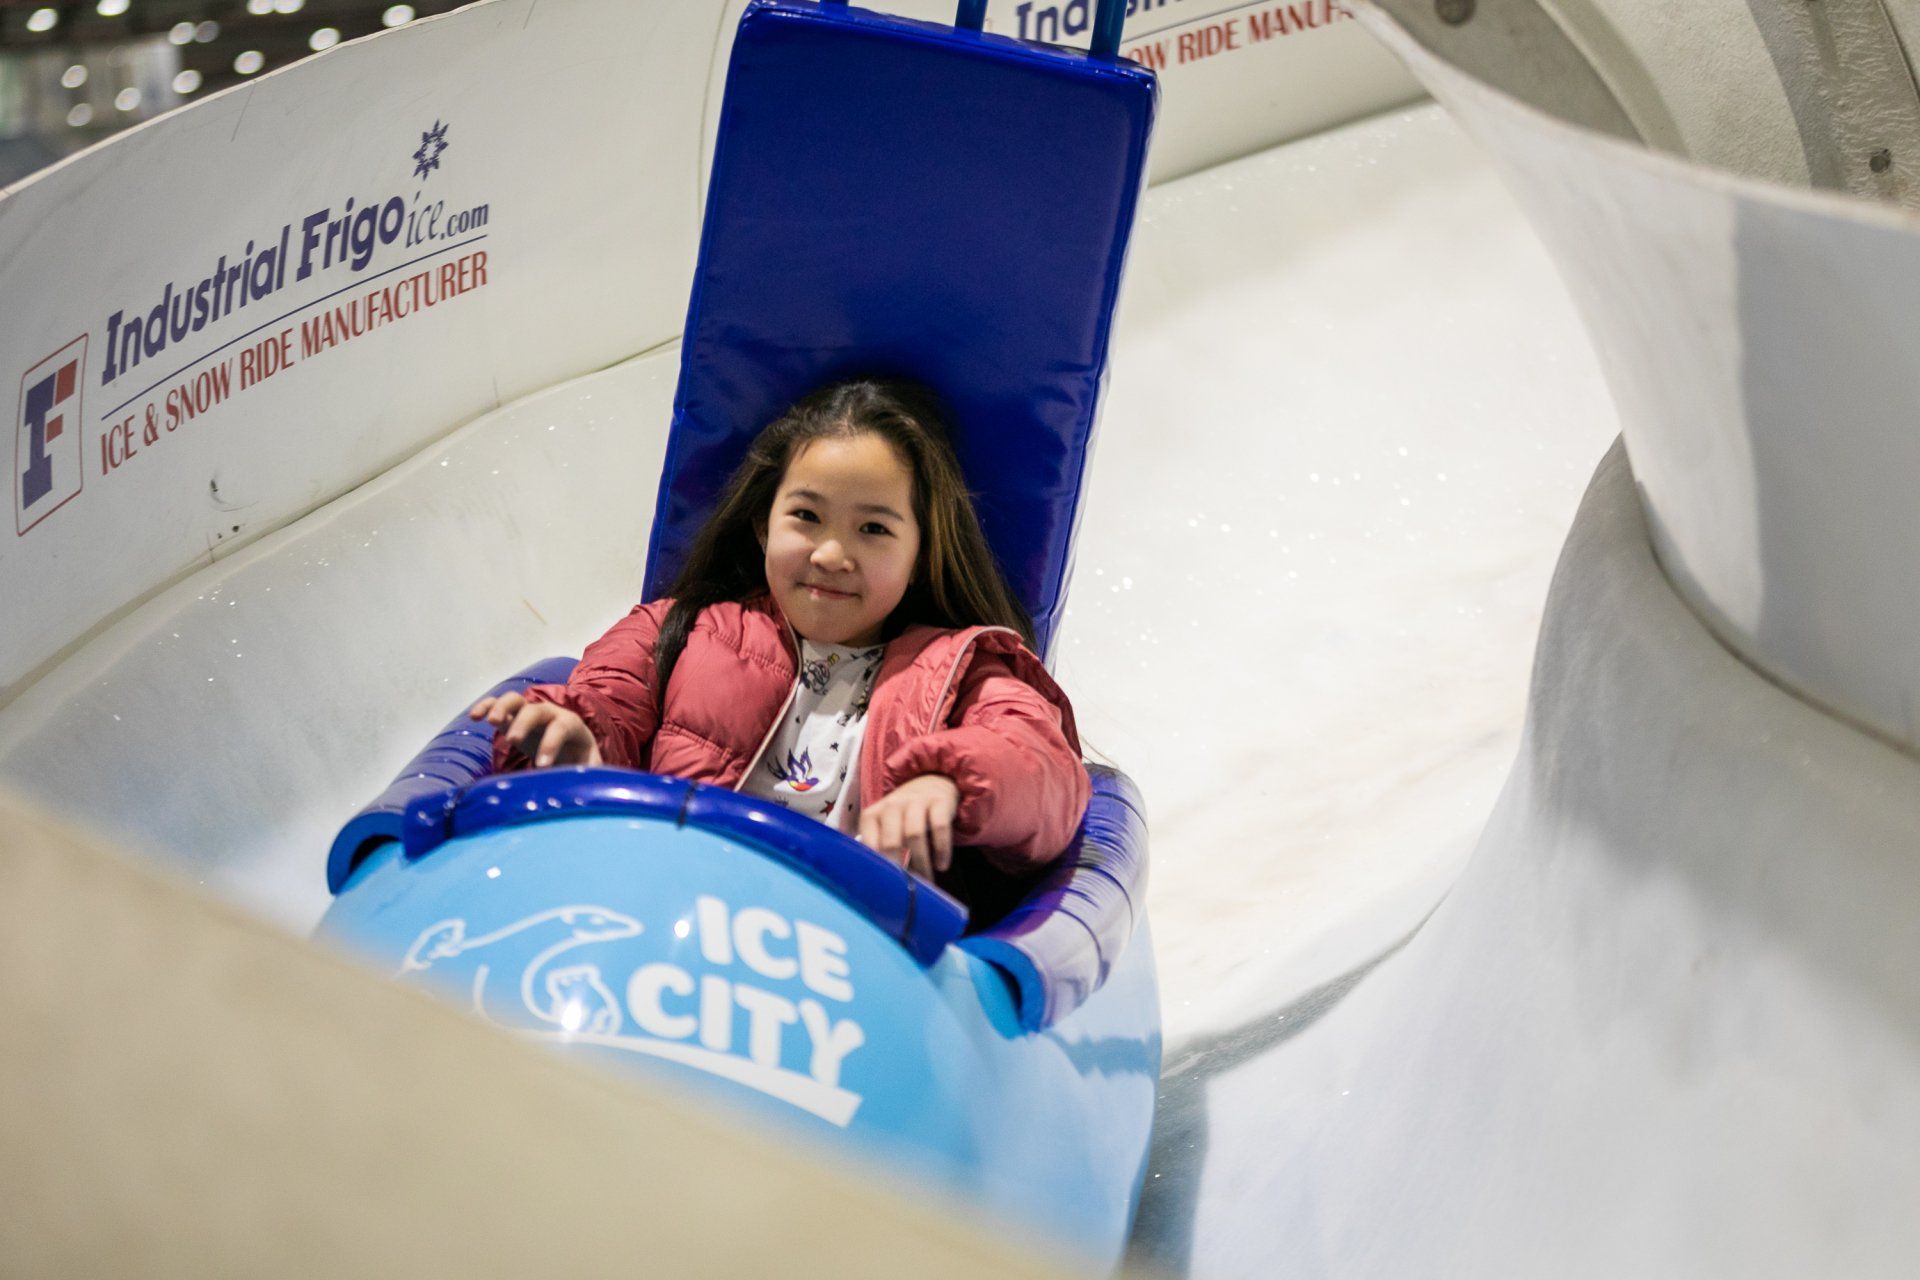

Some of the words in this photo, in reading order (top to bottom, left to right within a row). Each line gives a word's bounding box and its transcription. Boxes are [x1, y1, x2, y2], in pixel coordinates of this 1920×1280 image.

[1177, 18, 1241, 65] RIDE
[100, 413, 138, 476] ICE
[143, 402, 160, 446] &
[166, 356, 233, 433] SNOW
[239, 327, 295, 391] RIDE
[301, 250, 489, 361] MANUFACTURER
[101, 223, 292, 386] Industrial
[696, 895, 855, 1002] ICE
[627, 963, 865, 1088] CITY
